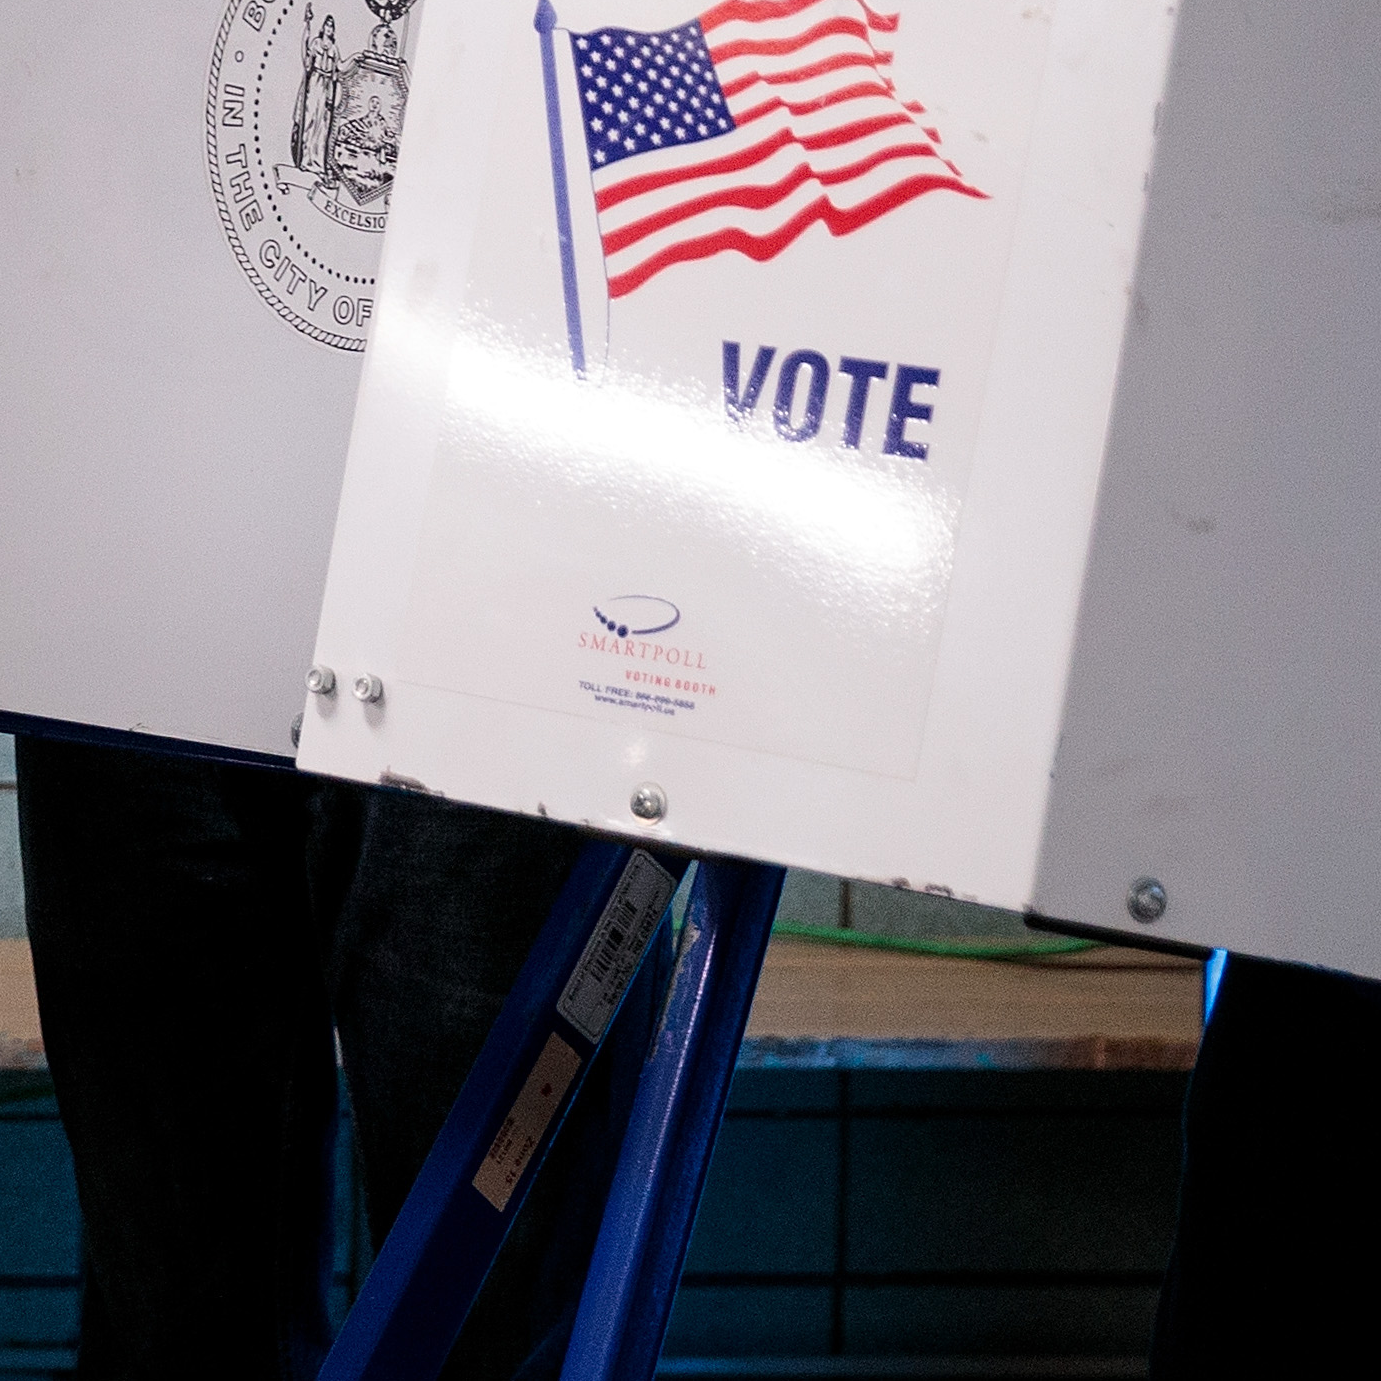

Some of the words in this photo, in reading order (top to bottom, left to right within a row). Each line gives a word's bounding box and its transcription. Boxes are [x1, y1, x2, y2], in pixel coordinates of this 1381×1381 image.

[222, 84, 246, 128] IN
[224, 143, 265, 232] THE
[258, 239, 328, 312] CITY
[332, 296, 374, 327] OF
[722, 339, 941, 461] VOTE
[578, 632, 706, 670] SMARTPOLL
[578, 680, 602, 693] TOLL
[625, 670, 671, 688] VOTING
